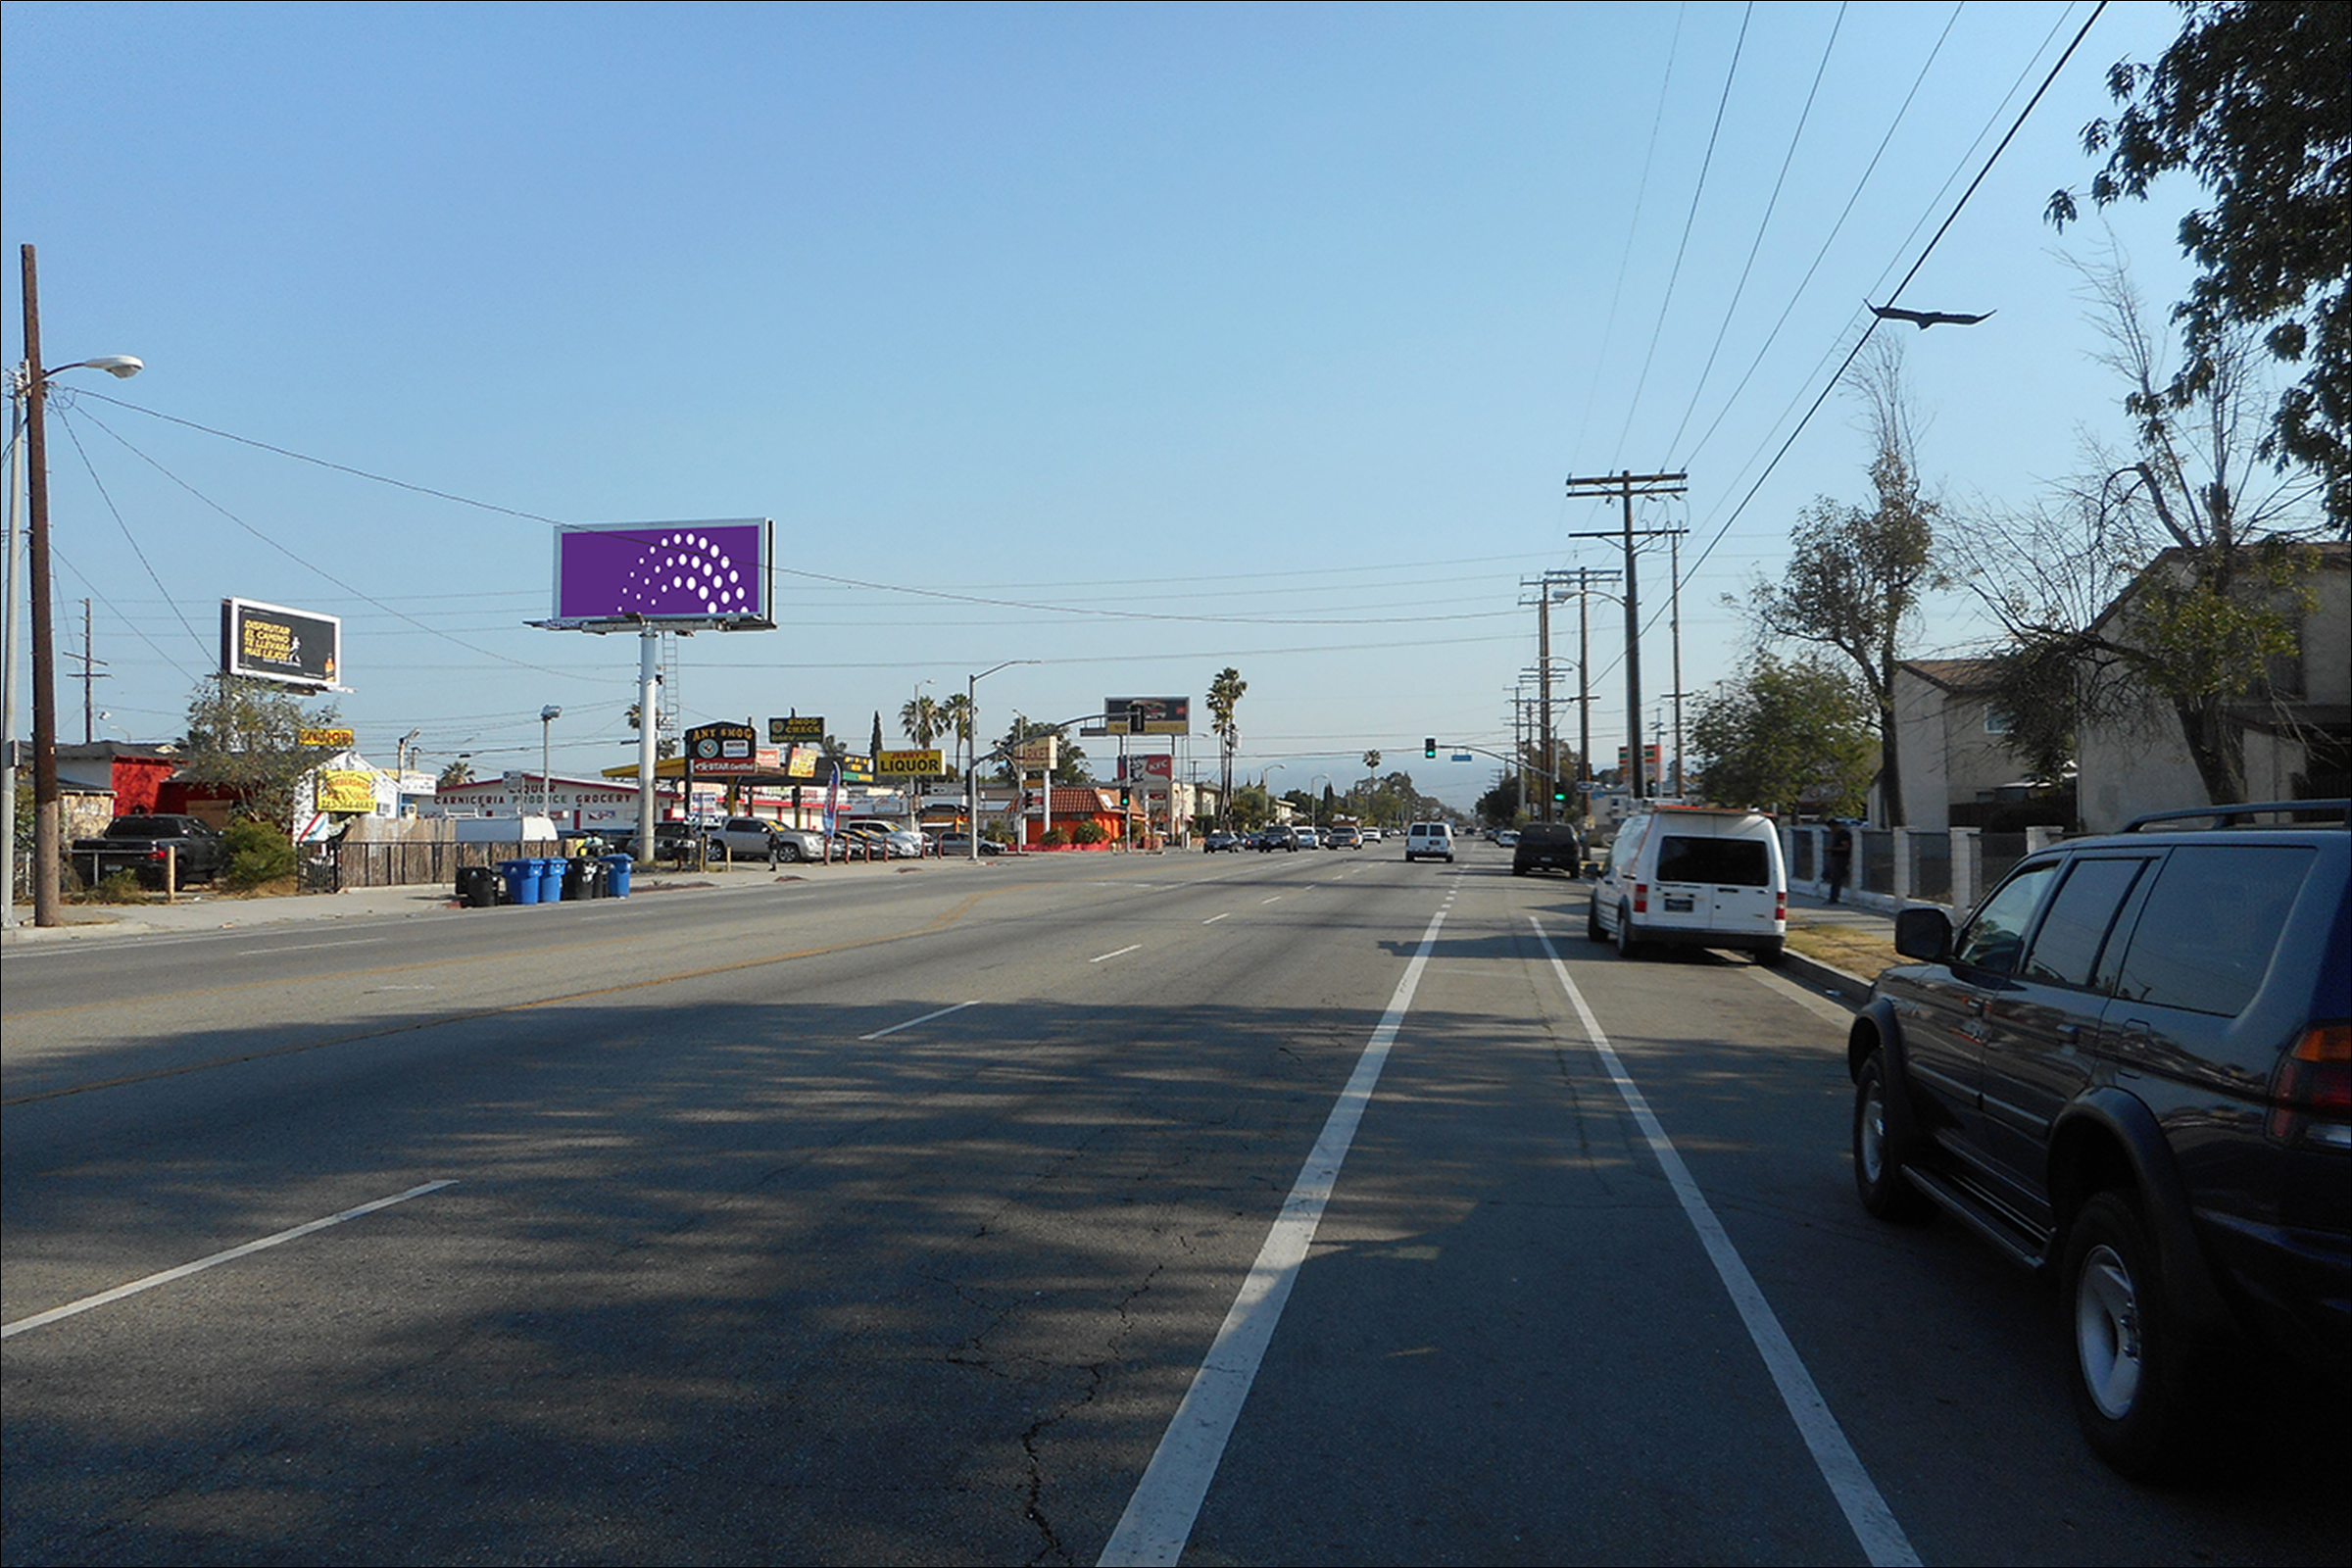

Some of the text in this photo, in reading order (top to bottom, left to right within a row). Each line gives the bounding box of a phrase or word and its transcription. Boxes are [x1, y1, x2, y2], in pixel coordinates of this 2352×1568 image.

[256, 630, 290, 644] CAMINO
[692, 727, 753, 742] ANY SMOG
[785, 725, 821, 734] CHECK
[880, 759, 939, 772] LIQUOR
[1149, 759, 1168, 771] KFC
[509, 784, 557, 795] QUOR
[433, 794, 632, 806] CARNICERIA PRODCE GROCERY
